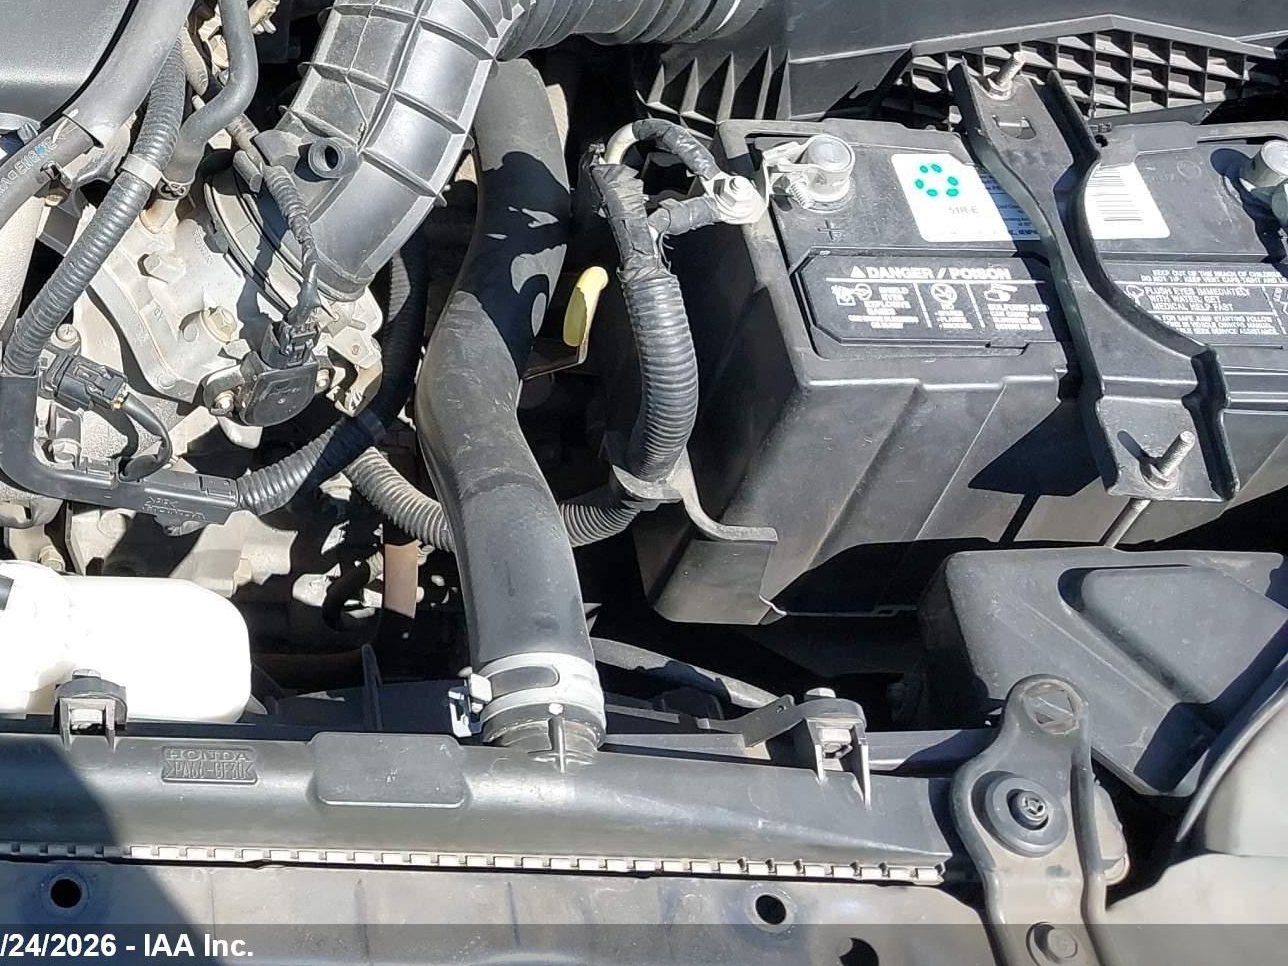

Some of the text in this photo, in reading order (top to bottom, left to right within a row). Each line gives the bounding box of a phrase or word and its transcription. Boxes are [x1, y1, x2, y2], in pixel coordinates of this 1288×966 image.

[865, 265, 935, 279] DANGER
[949, 267, 1012, 280] POISON
[1143, 286, 1251, 297] FLUSH EYES IMMEDIATELY
[1147, 295, 1172, 303] WITH
[1205, 296, 1222, 304] GET
[1151, 303, 1235, 312] MEDICAL HELP FAST
[166, 749, 248, 761] HONDA
